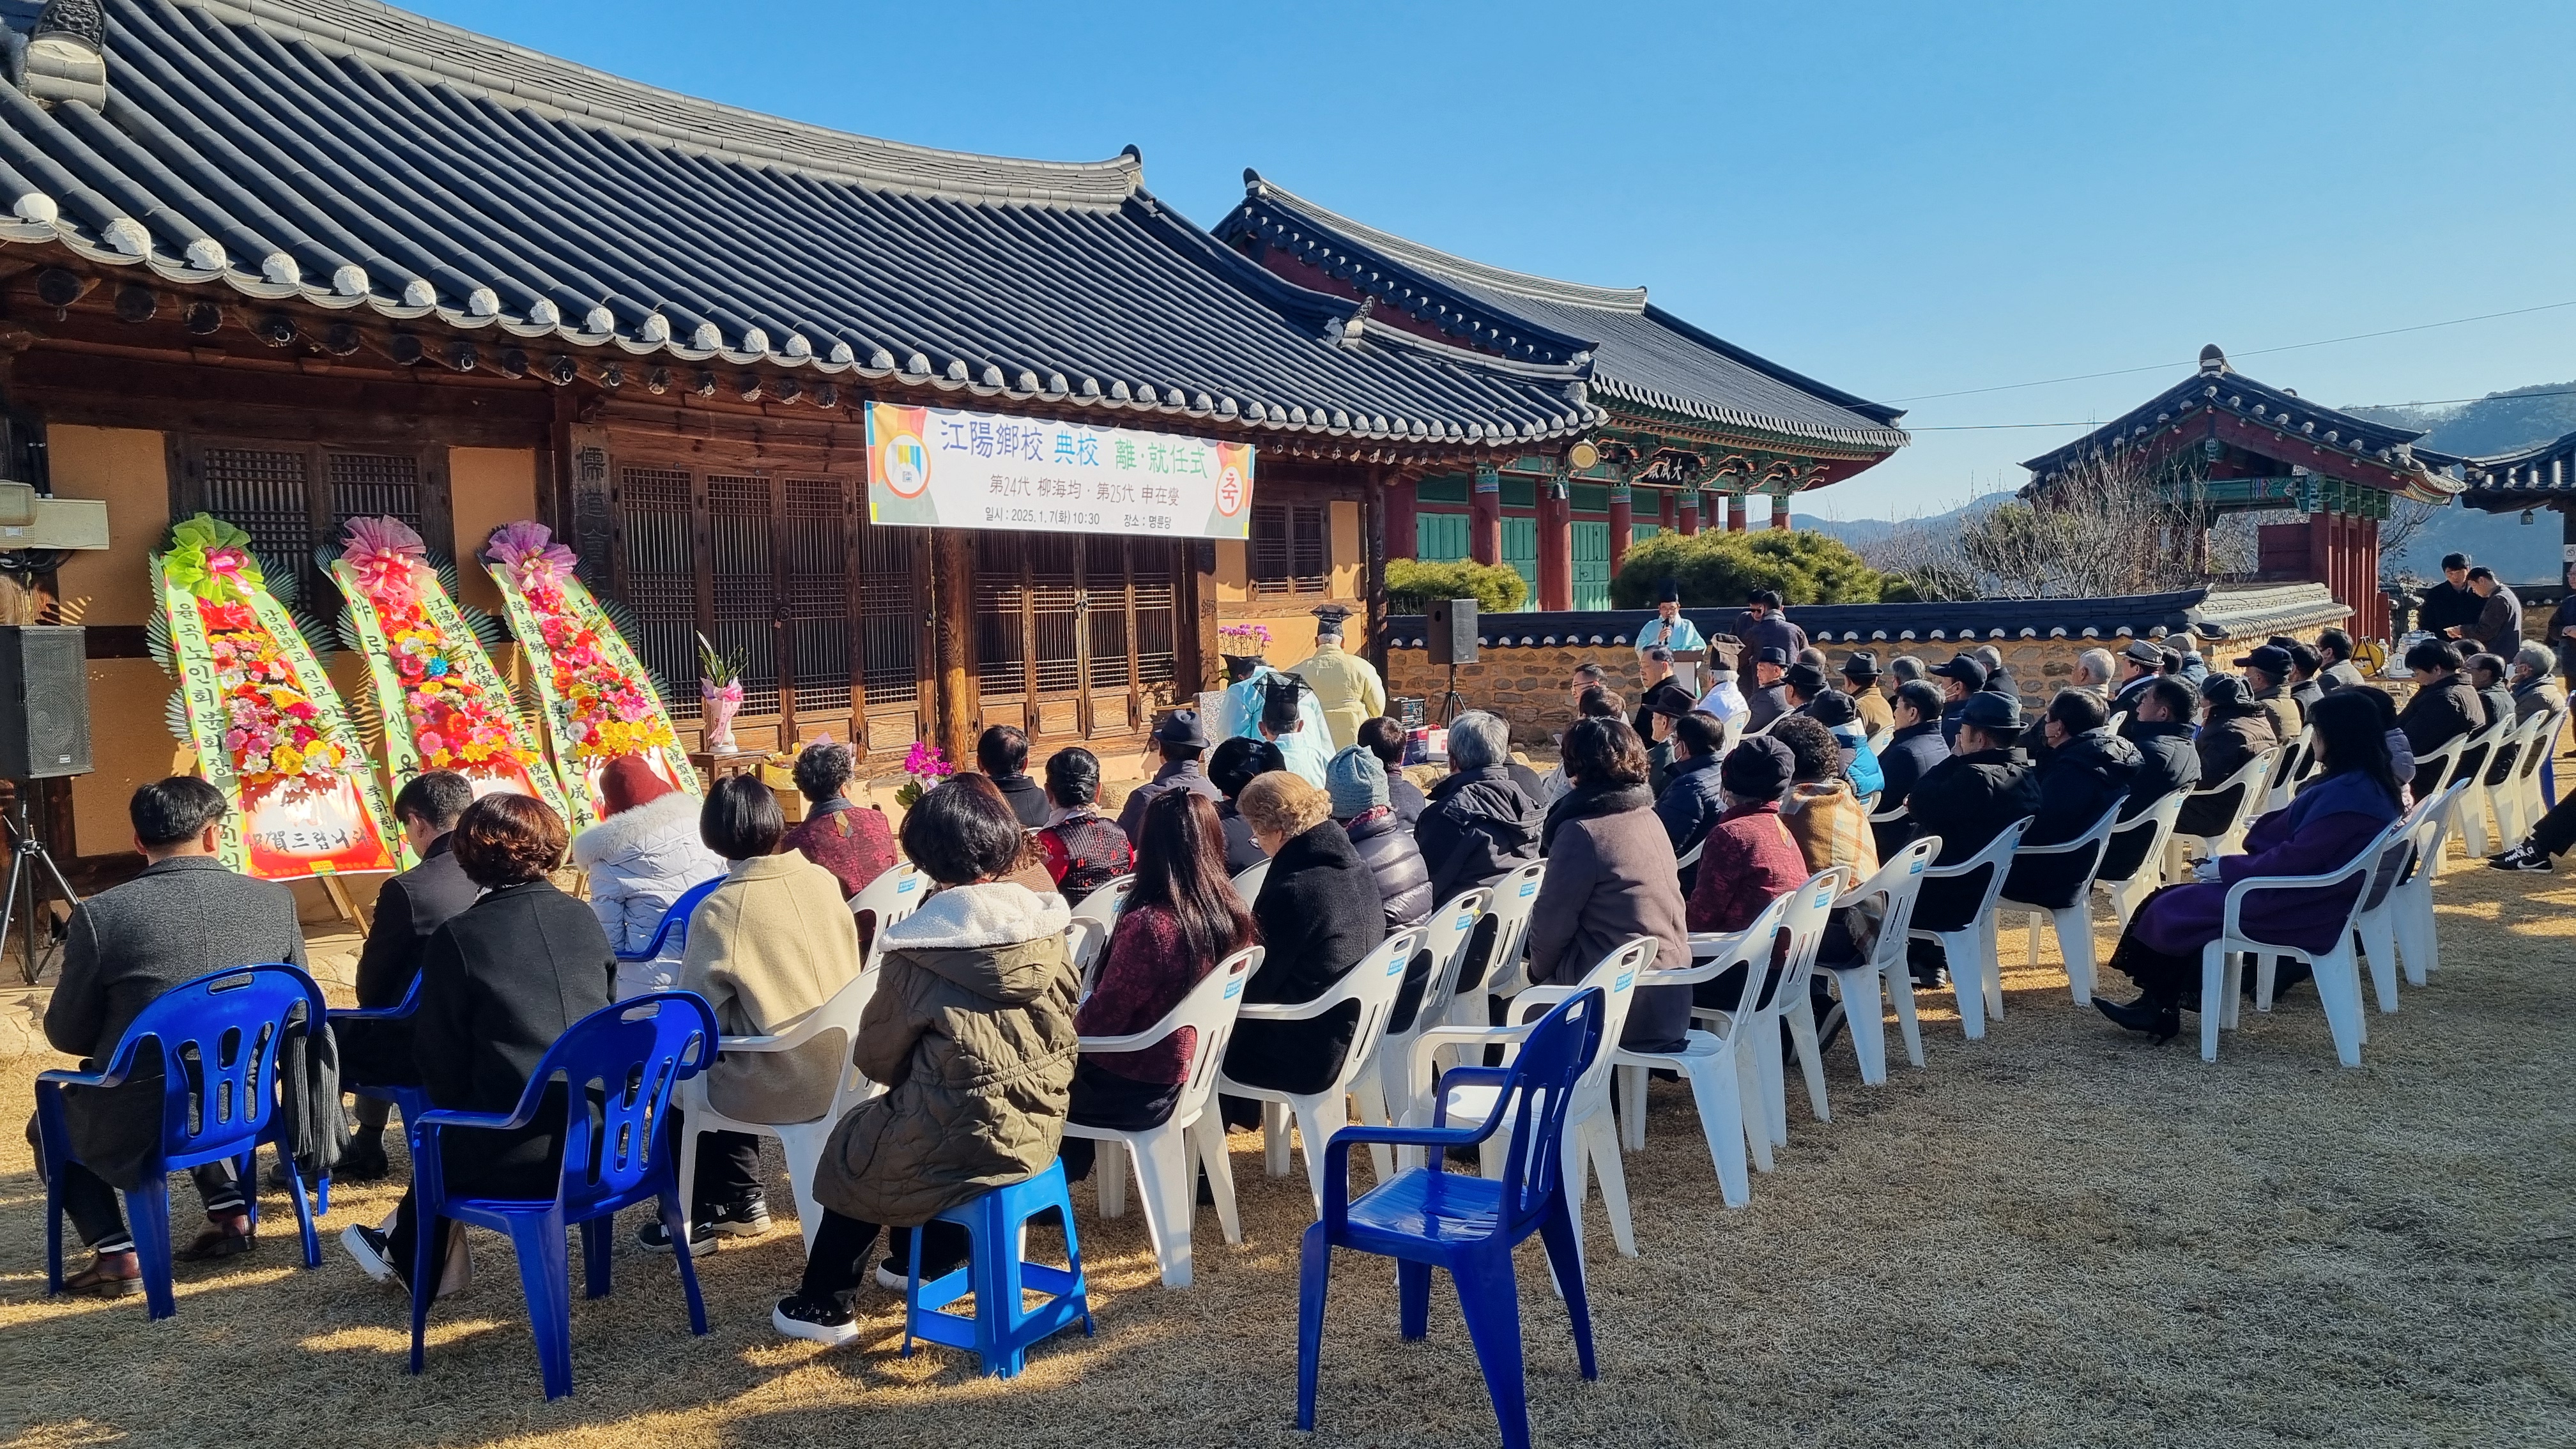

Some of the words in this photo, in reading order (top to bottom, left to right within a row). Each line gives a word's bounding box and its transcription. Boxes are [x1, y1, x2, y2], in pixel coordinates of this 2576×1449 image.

[1054, 429, 1100, 466] 典校
[990, 473, 1031, 496] 第24代
[1037, 477, 1081, 499] 柳海均
[1097, 481, 1135, 503] 第25代
[1222, 473, 1238, 508] 축
[1149, 515, 1172, 529] 명륜당
[302, 670, 332, 698] 전교
[667, 752, 704, 807] 祝賀합니
